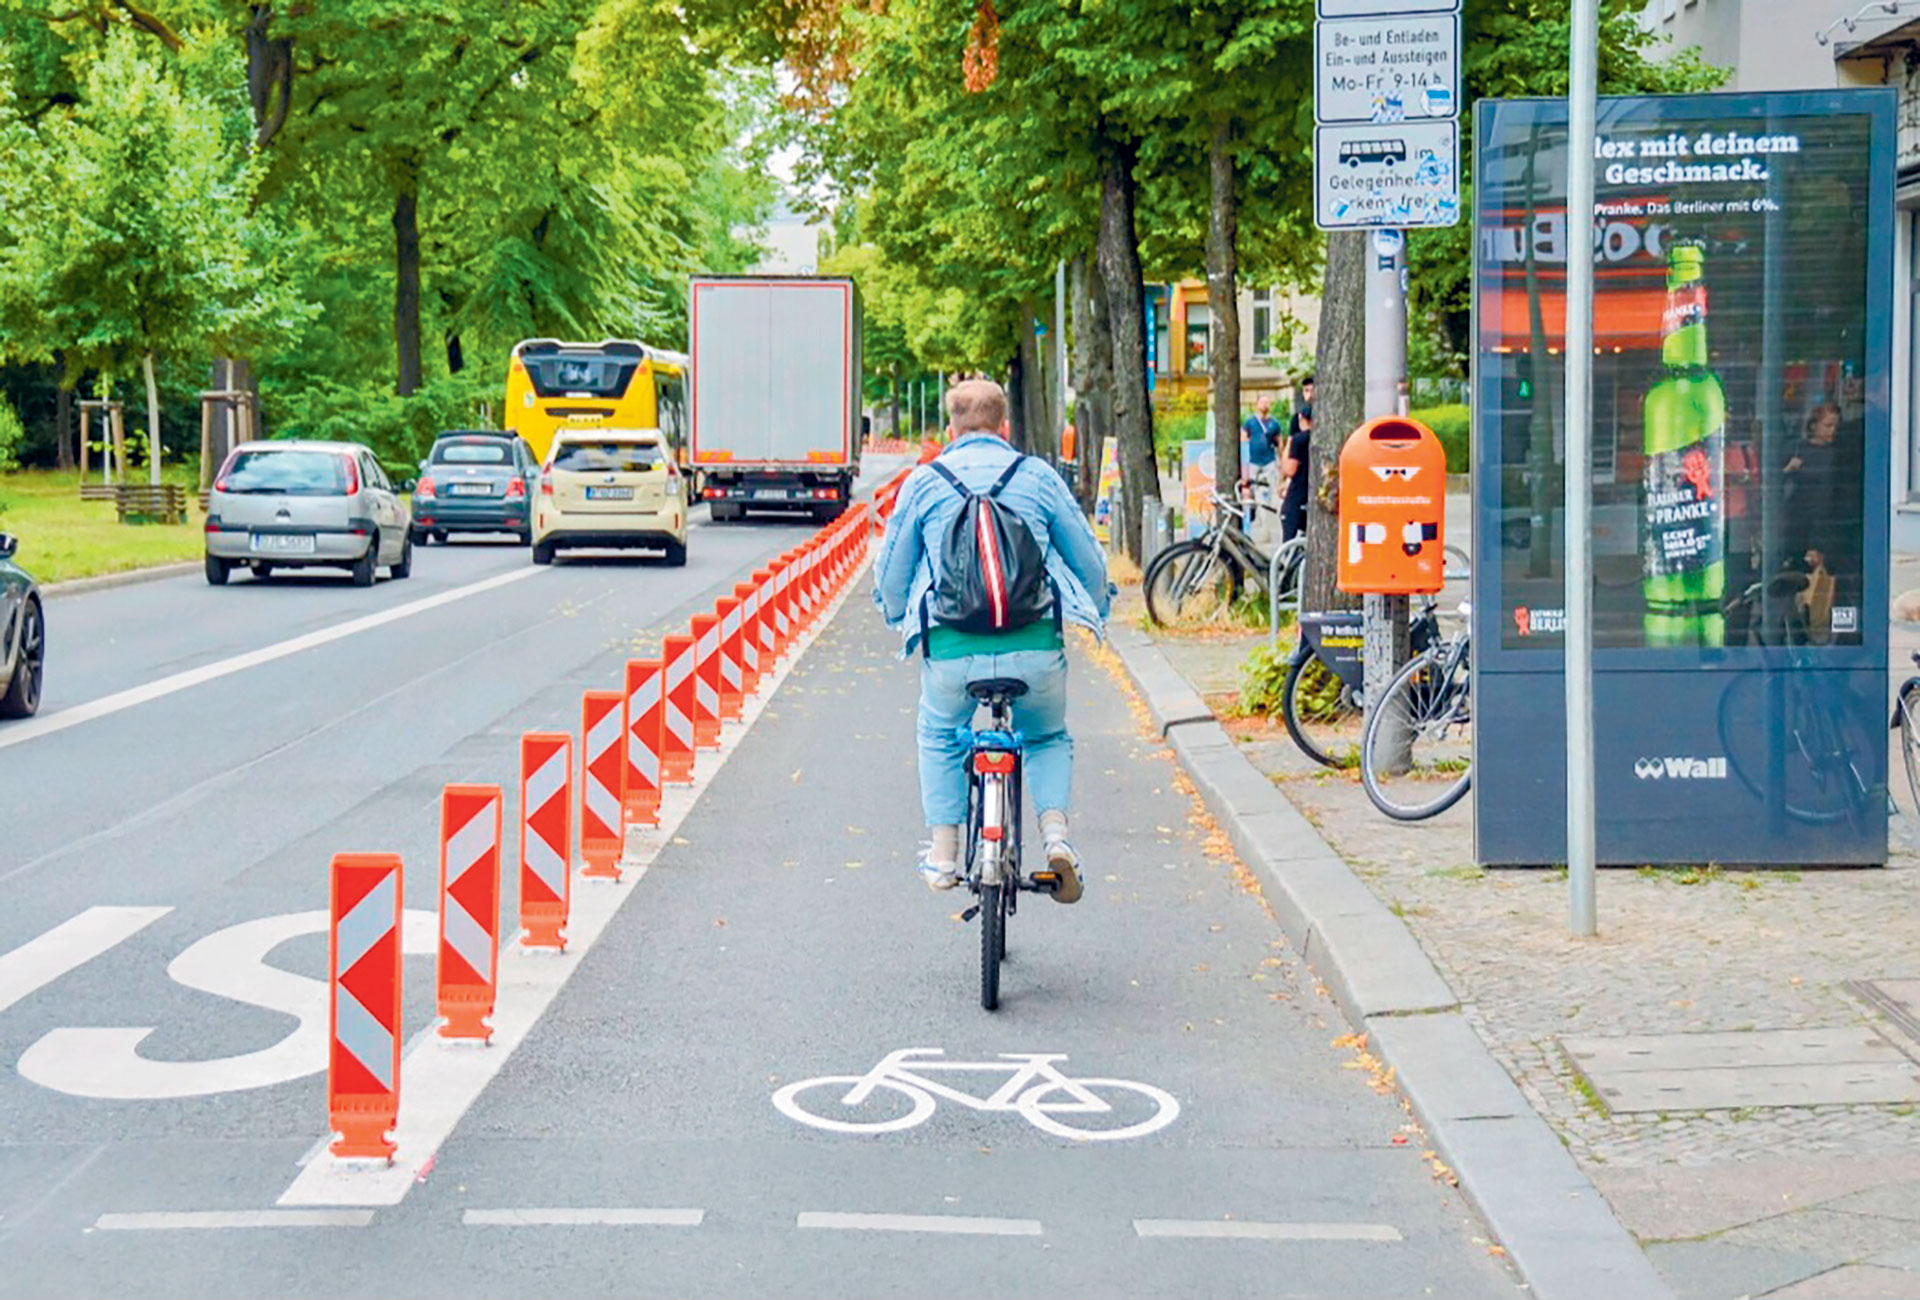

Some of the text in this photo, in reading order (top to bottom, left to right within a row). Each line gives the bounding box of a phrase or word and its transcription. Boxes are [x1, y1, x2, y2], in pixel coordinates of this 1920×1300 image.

[1335, 29, 1439, 47] Be- und Entladen
[1326, 50, 1447, 67] Ein- und Aussteigen
[1332, 74, 1384, 91] Mo-Fr
[1394, 72, 1427, 88] 9-14
[1594, 132, 1799, 158] lex mit deinem
[1605, 159, 1769, 184] Geschmack.
[1329, 173, 1416, 191] Gelegenhe
[1402, 193, 1423, 208] fre
[1594, 202, 1643, 215] Pranke.
[1647, 202, 1671, 214] Das
[1674, 200, 1723, 214] Berliner
[1726, 200, 1749, 212] mit
[1656, 501, 1710, 524] PRANKE
[1664, 757, 1726, 778] Wall
